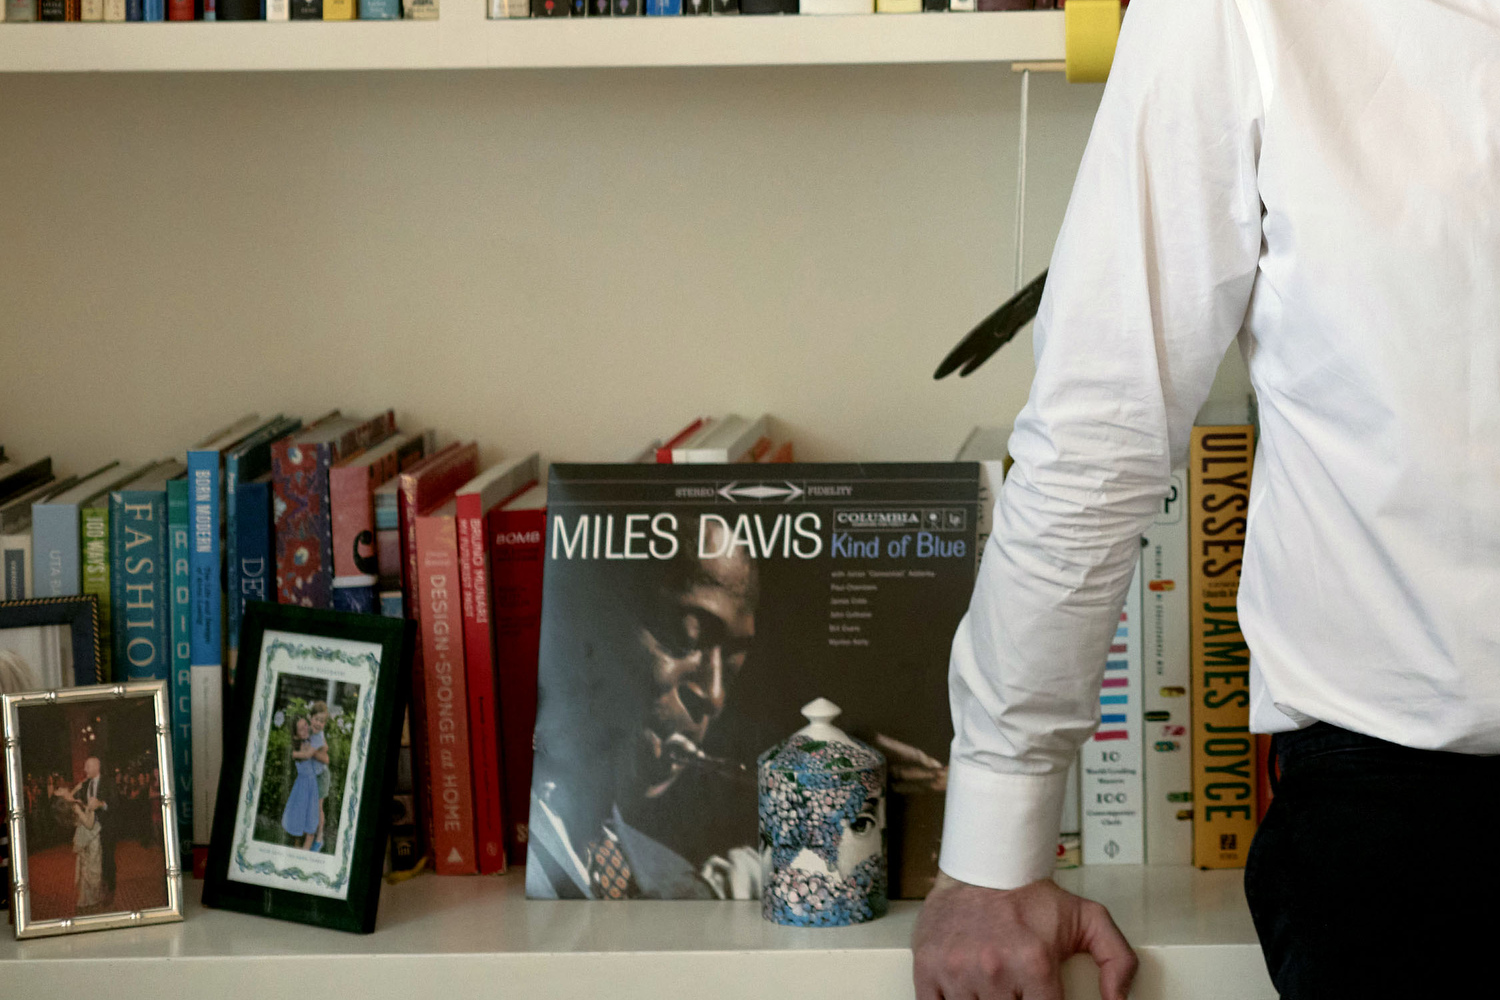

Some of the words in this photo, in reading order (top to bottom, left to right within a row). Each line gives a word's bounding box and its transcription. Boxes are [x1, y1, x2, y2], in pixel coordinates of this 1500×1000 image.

[196, 470, 211, 500] BORN
[676, 487, 715, 498] STEREO
[808, 486, 851, 497] FIDELITY
[1202, 432, 1249, 577] ULYSSES
[86, 517, 105, 538] 100
[196, 504, 211, 553] MODERN
[496, 531, 542, 545] BOMB
[551, 513, 678, 559] MILES
[698, 513, 823, 559] DAVIS
[838, 511, 920, 525] COLUMBIA
[50, 551, 61, 576] UTA
[87, 540, 105, 574] WAYS
[470, 518, 486, 566] BRUNO
[830, 533, 880, 558] Kind
[888, 533, 911, 558] of
[917, 532, 966, 558] Blue
[124, 502, 156, 684] FASHIO
[473, 568, 489, 623] MUNARI
[1203, 602, 1248, 708] JAMES
[1204, 722, 1252, 822] JOYCE
[443, 774, 460, 832] HOME
